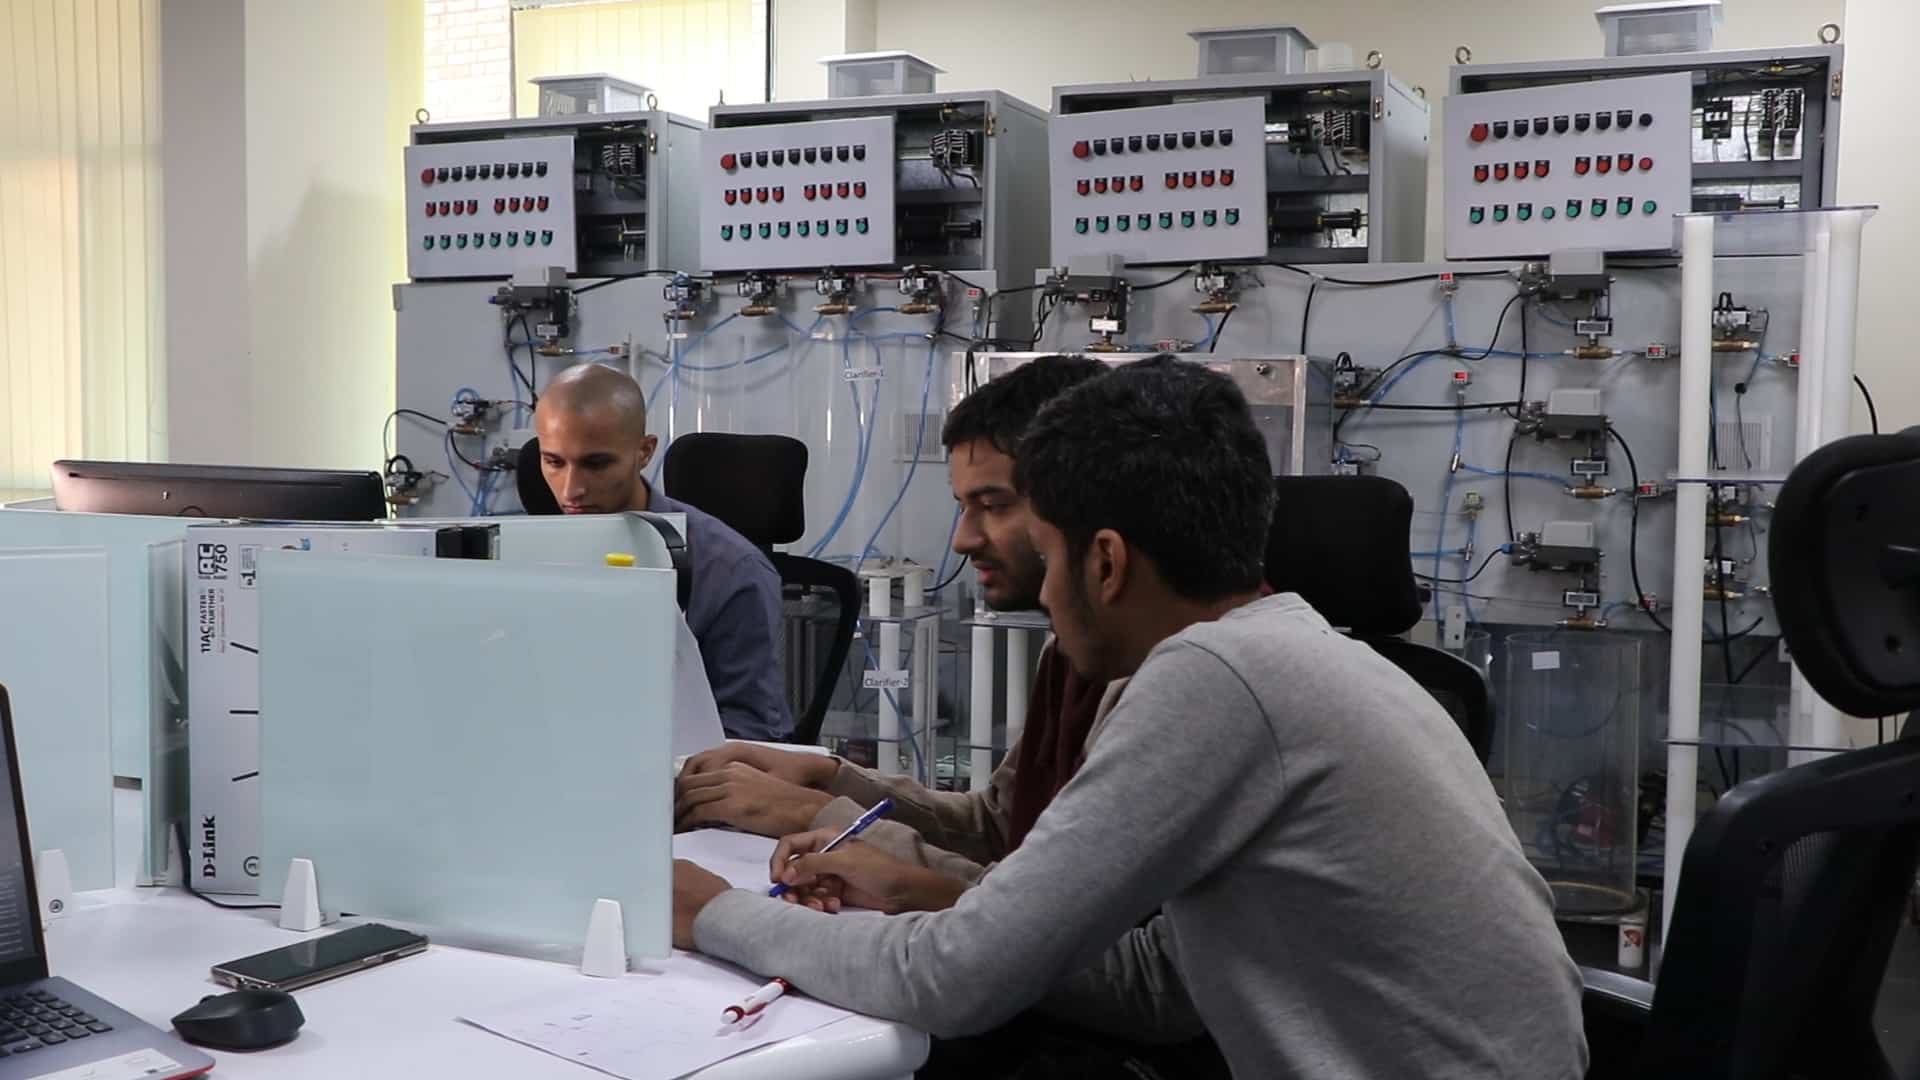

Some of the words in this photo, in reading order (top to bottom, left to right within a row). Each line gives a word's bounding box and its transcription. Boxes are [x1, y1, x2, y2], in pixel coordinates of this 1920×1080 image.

[844, 368, 884, 379] Clarifier-1
[198, 544, 215, 575] AC
[215, 544, 228, 573] 750
[200, 626, 211, 654] 11AC
[865, 677, 908, 688] Clarifier-2
[202, 815, 216, 879] D-Link
